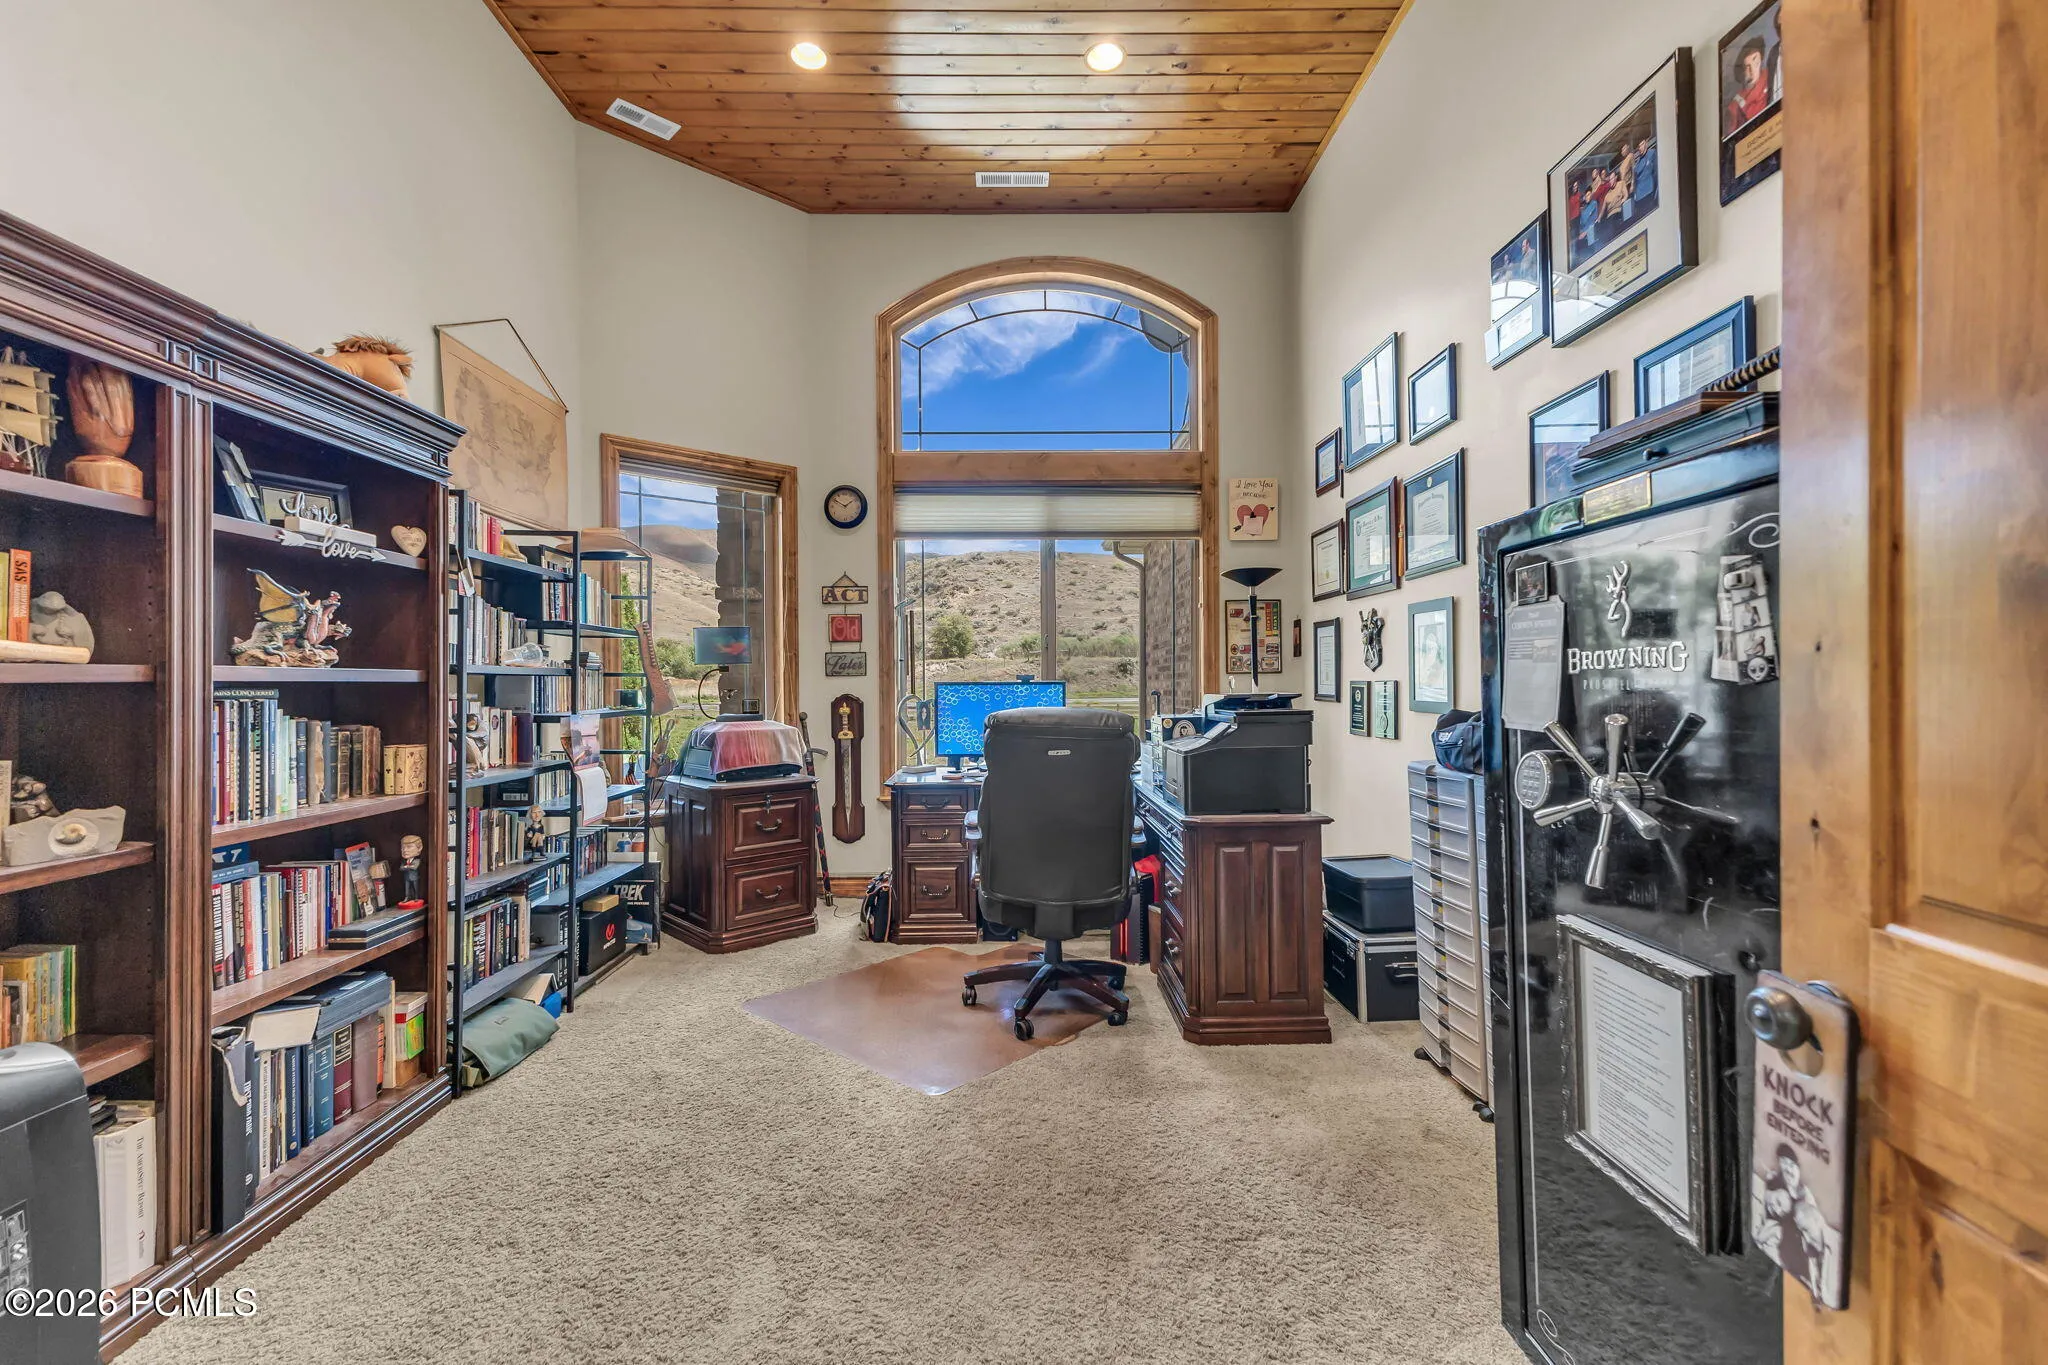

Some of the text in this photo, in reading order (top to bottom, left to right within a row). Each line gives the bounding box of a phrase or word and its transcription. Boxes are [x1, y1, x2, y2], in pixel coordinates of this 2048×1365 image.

[321, 528, 359, 560] love
[14, 560, 28, 582] SAS
[823, 588, 867, 602] ACT
[832, 617, 860, 641] Old
[827, 655, 864, 674] Later
[1567, 640, 1689, 675] BROWNING
[231, 689, 275, 697] CONQUERED
[613, 884, 647, 901] TREK
[1762, 1064, 1834, 1126] KNOCK
[1773, 1098, 1824, 1142] BEFORE
[1766, 1111, 1831, 1165] ENTERING
